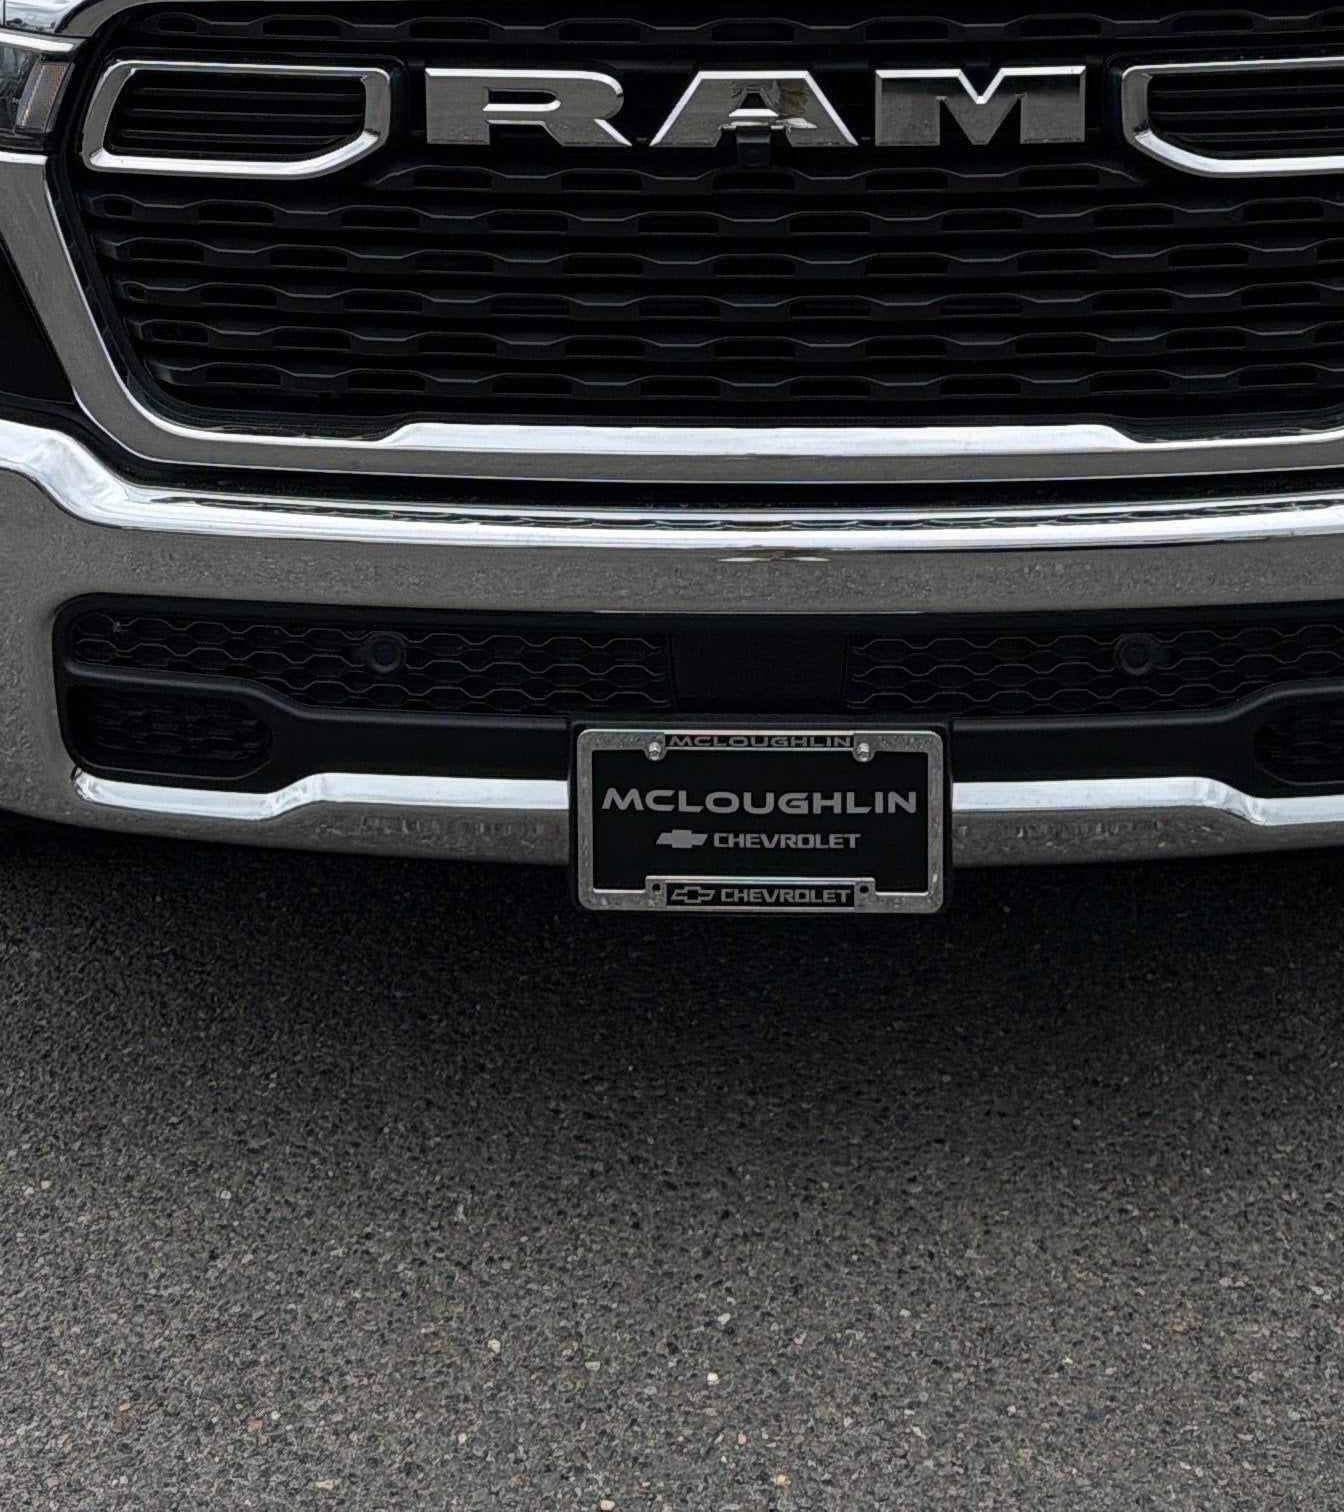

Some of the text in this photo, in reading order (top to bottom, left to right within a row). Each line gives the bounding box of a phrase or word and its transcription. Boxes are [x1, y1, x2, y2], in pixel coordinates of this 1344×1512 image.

[425, 65, 1087, 148] RAM
[669, 736, 852, 748] MCLOUGHLIN
[602, 788, 917, 814] MCLOUGHLIN
[713, 833, 862, 849] CHEVROLET
[721, 889, 851, 904] CHEVROLET
